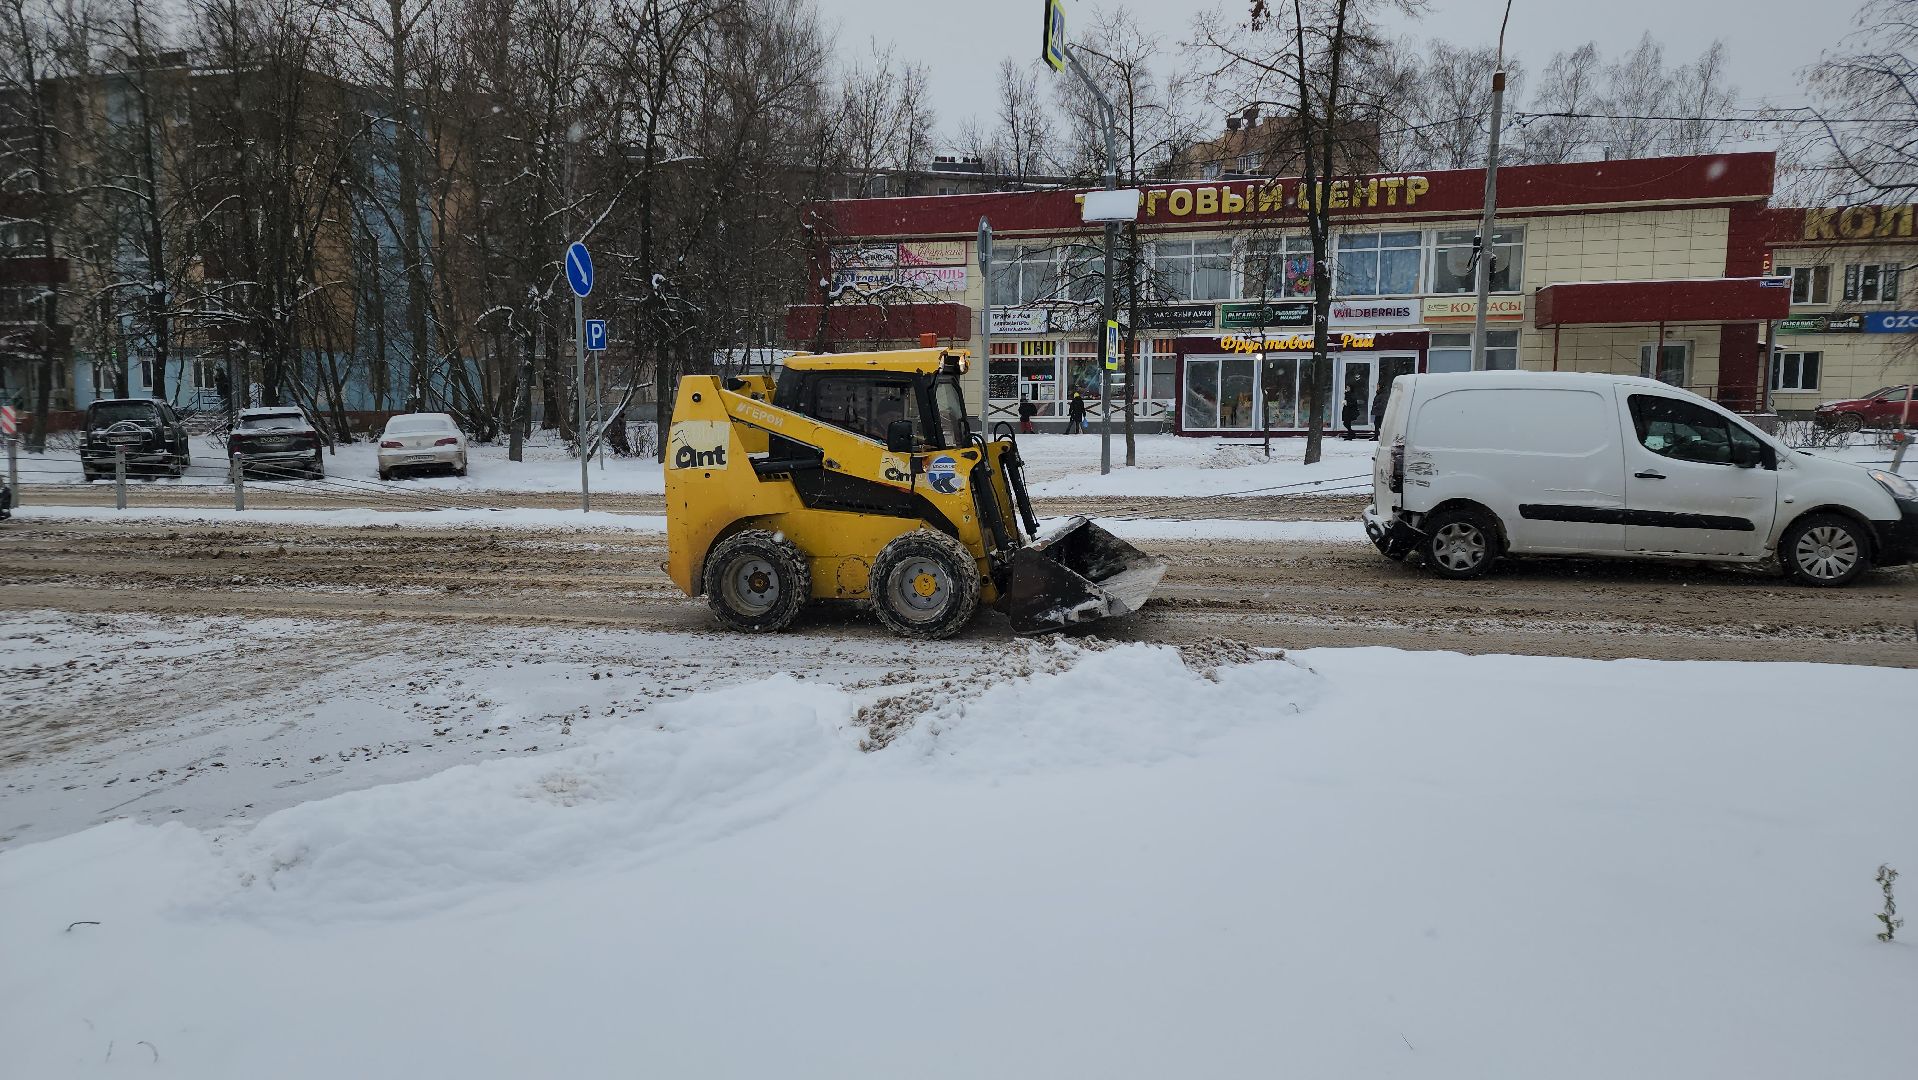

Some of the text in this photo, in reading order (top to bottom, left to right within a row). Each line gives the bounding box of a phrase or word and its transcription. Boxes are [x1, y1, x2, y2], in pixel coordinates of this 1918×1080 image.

[1075, 178, 1283, 218] ГОВЫЙ
[1333, 307, 1410, 318] WILDBERRIES
[1450, 300, 1521, 312] КОЛАСЫ
[592, 324, 602, 346] P
